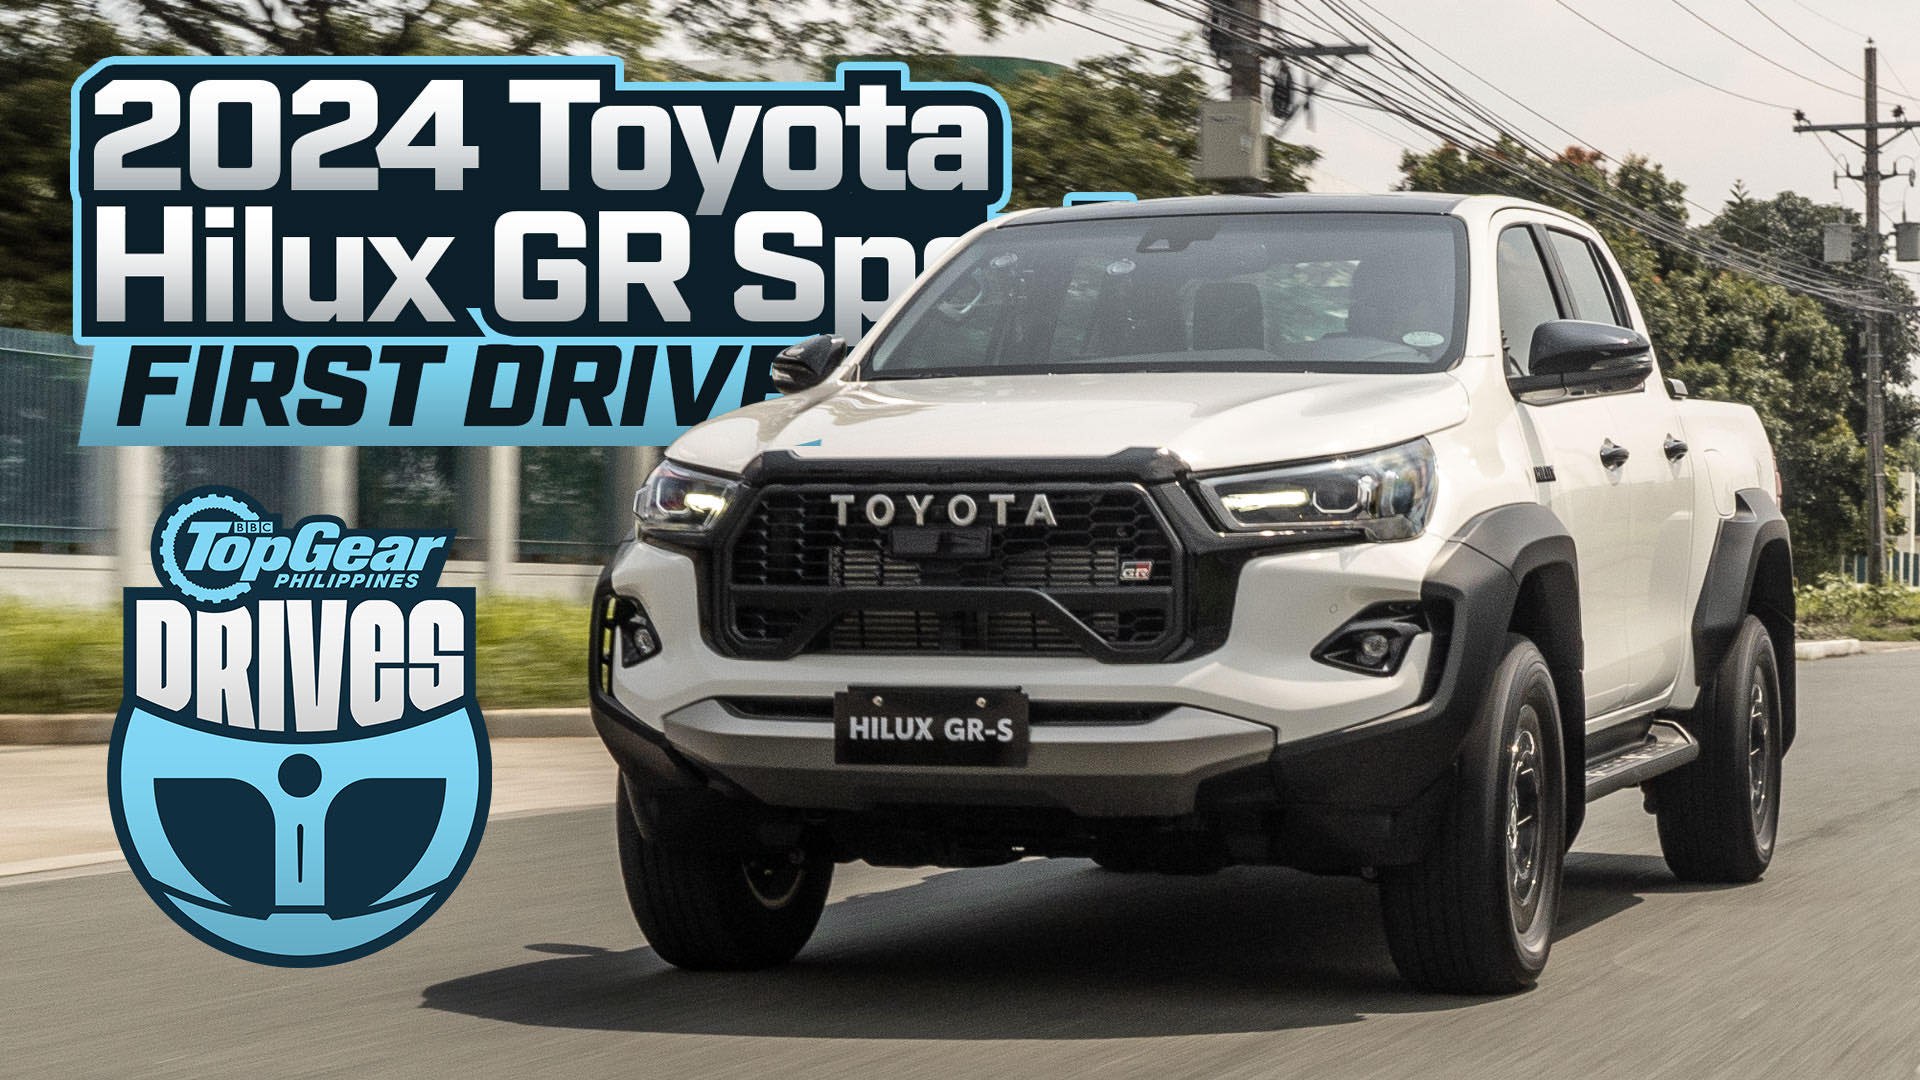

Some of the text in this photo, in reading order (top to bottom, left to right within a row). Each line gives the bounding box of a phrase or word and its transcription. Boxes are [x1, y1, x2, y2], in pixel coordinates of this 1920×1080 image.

[830, 493, 1057, 526] TOYOTA
[849, 716, 1014, 742] HILUX GR-S
